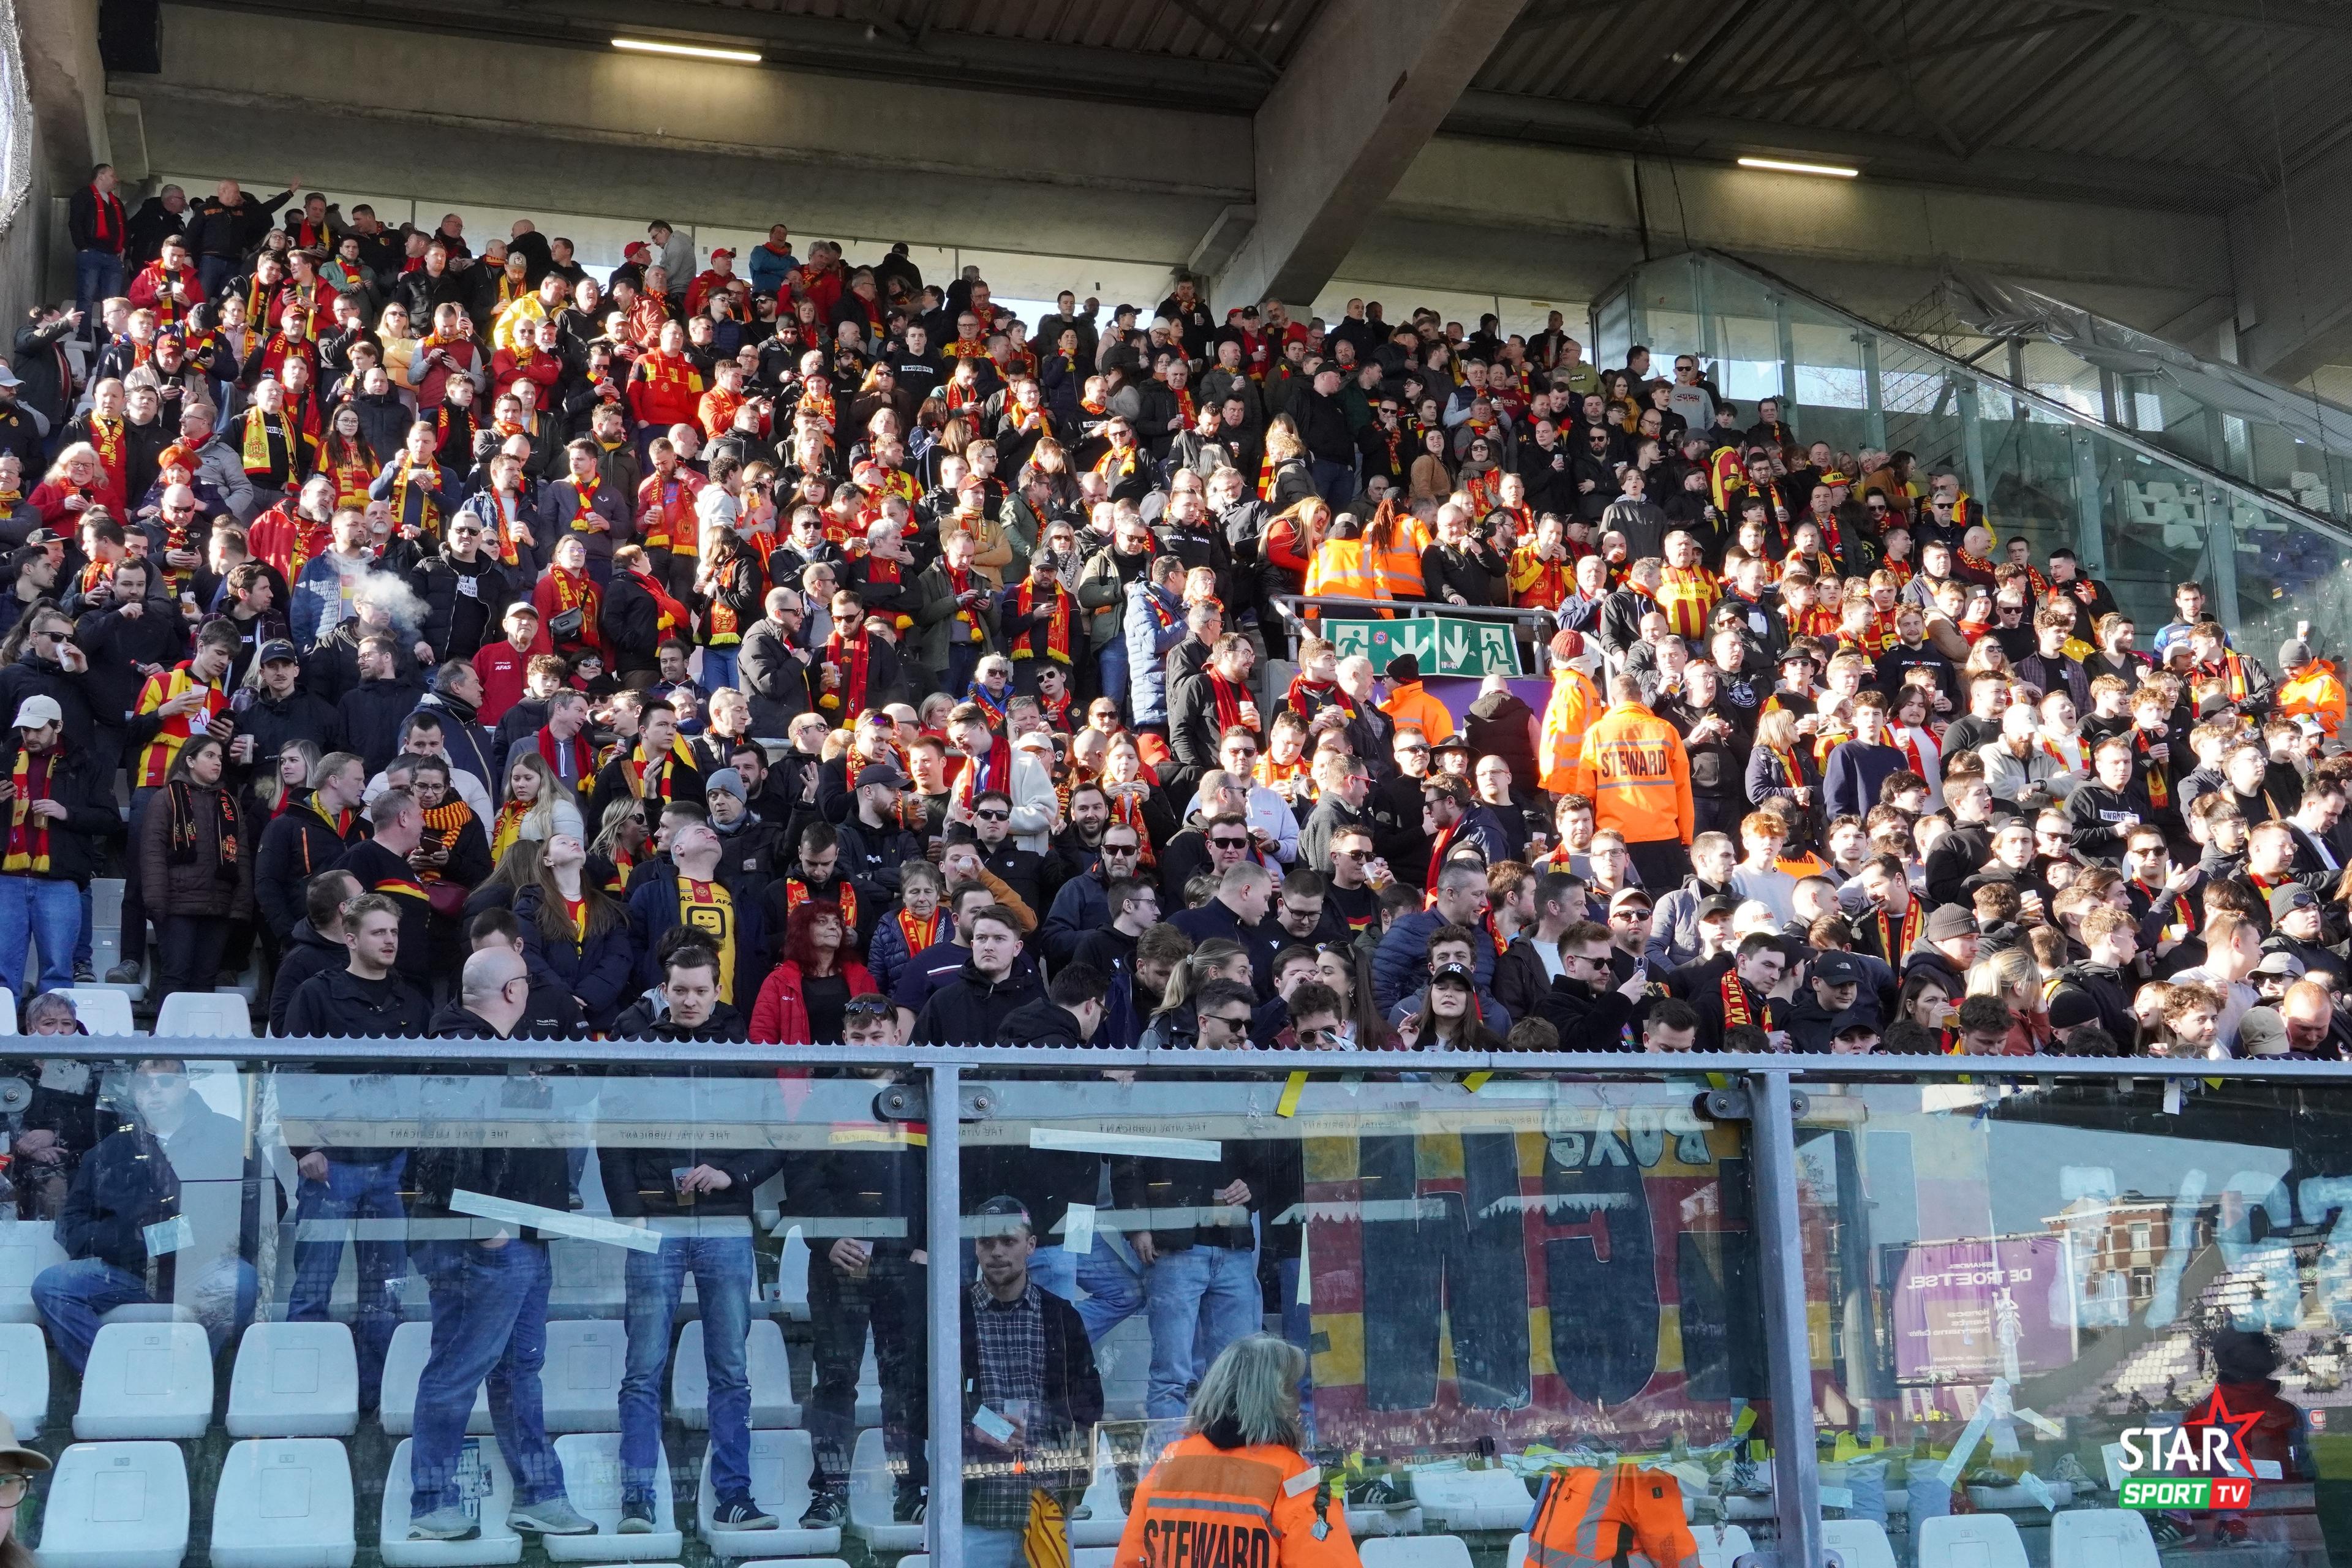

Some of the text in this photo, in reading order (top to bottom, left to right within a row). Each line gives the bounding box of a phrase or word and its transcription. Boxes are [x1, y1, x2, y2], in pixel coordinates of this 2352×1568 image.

[1193, 536, 1210, 545] KANI
[1677, 586, 1708, 596] telenet
[1601, 749, 1667, 778] STEWARD
[1143, 1519, 1270, 1568] STEWARD
